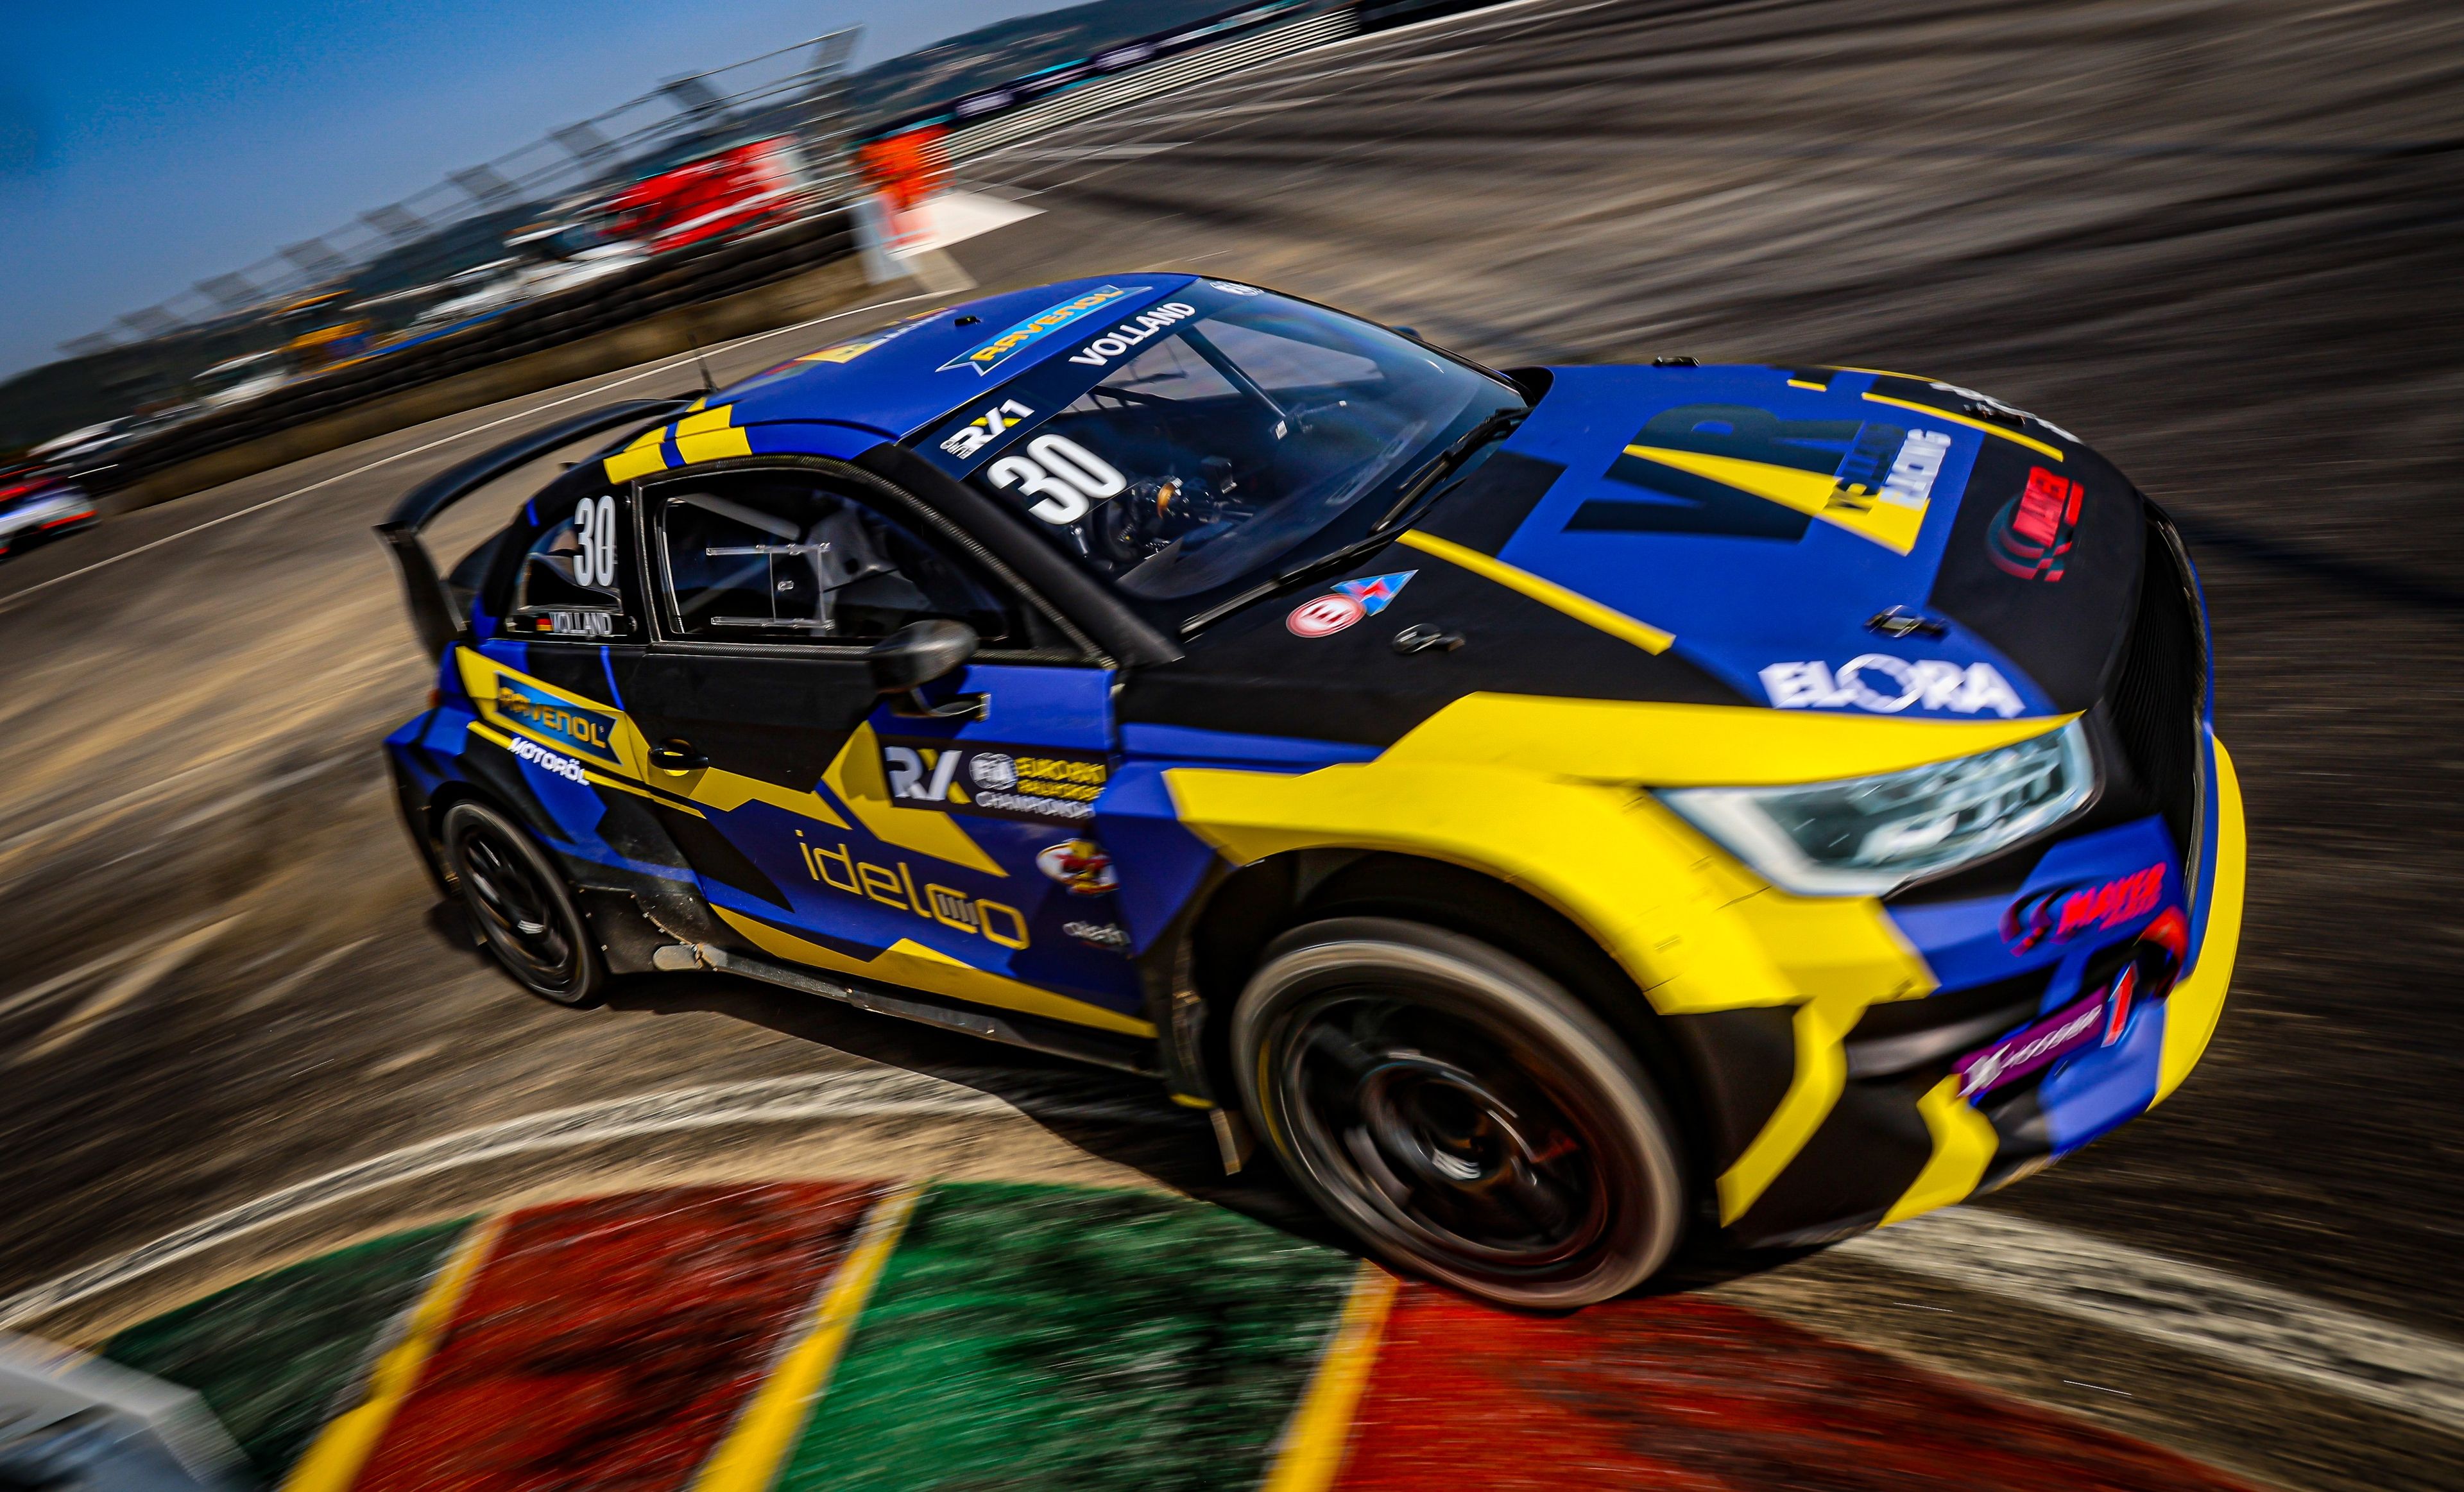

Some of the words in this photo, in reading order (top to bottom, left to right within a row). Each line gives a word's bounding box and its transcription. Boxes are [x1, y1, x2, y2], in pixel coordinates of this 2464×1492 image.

[970, 286, 1127, 362] RAVENOL
[1069, 302, 1195, 366] VOLLAND
[986, 434, 1127, 525] 30
[1878, 428, 1951, 511] RACING
[574, 495, 616, 587] 30
[549, 612, 613, 635] VOLLAND
[499, 687, 606, 748] RAVENOL
[1758, 653, 2026, 719] ELORA
[507, 737, 590, 786] MOTORÖL
[886, 746, 971, 805] RX
[975, 791, 1096, 819] CHAMPIONSH
